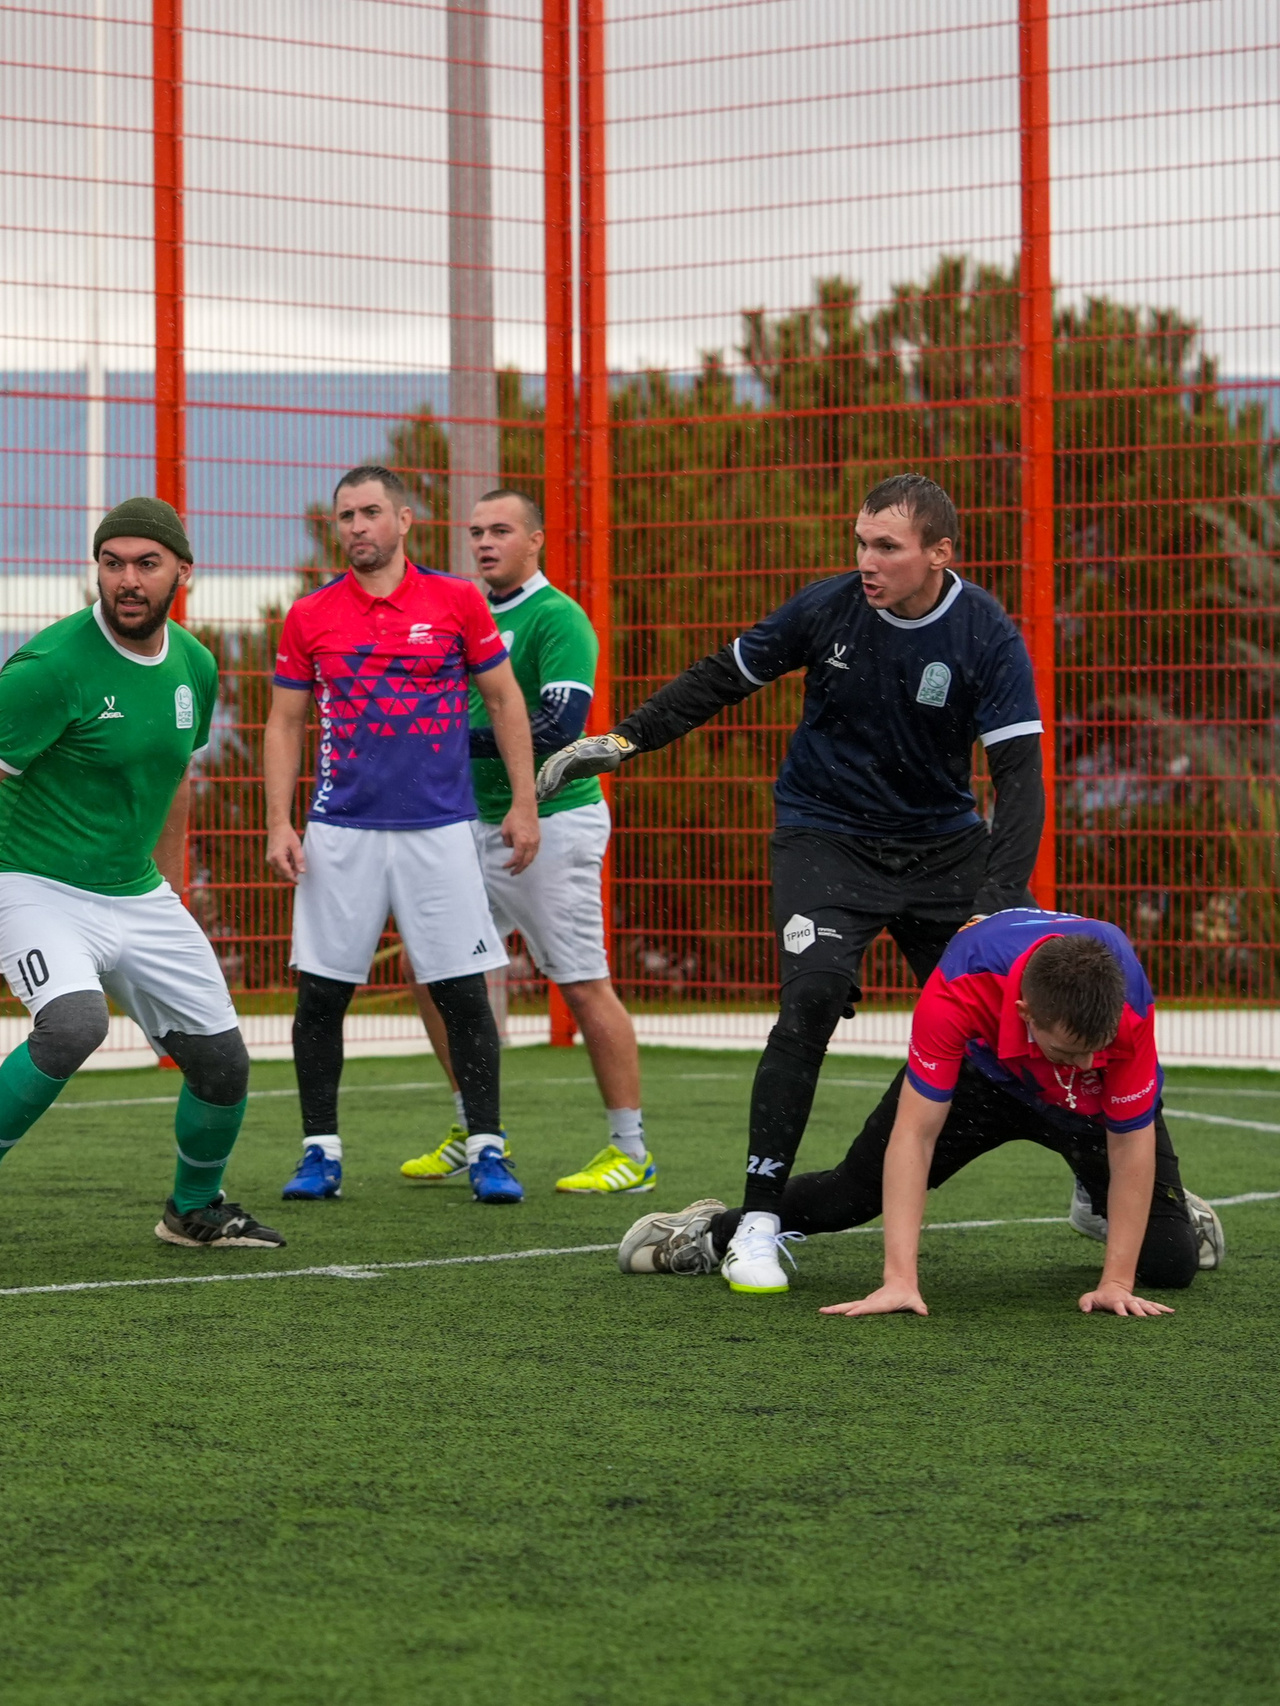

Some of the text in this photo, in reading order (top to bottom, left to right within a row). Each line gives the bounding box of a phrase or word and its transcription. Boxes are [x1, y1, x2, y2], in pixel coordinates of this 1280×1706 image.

[786, 928, 811, 942] ТРИО
[17, 948, 50, 997] 10
[746, 1154, 785, 1179] 2K
